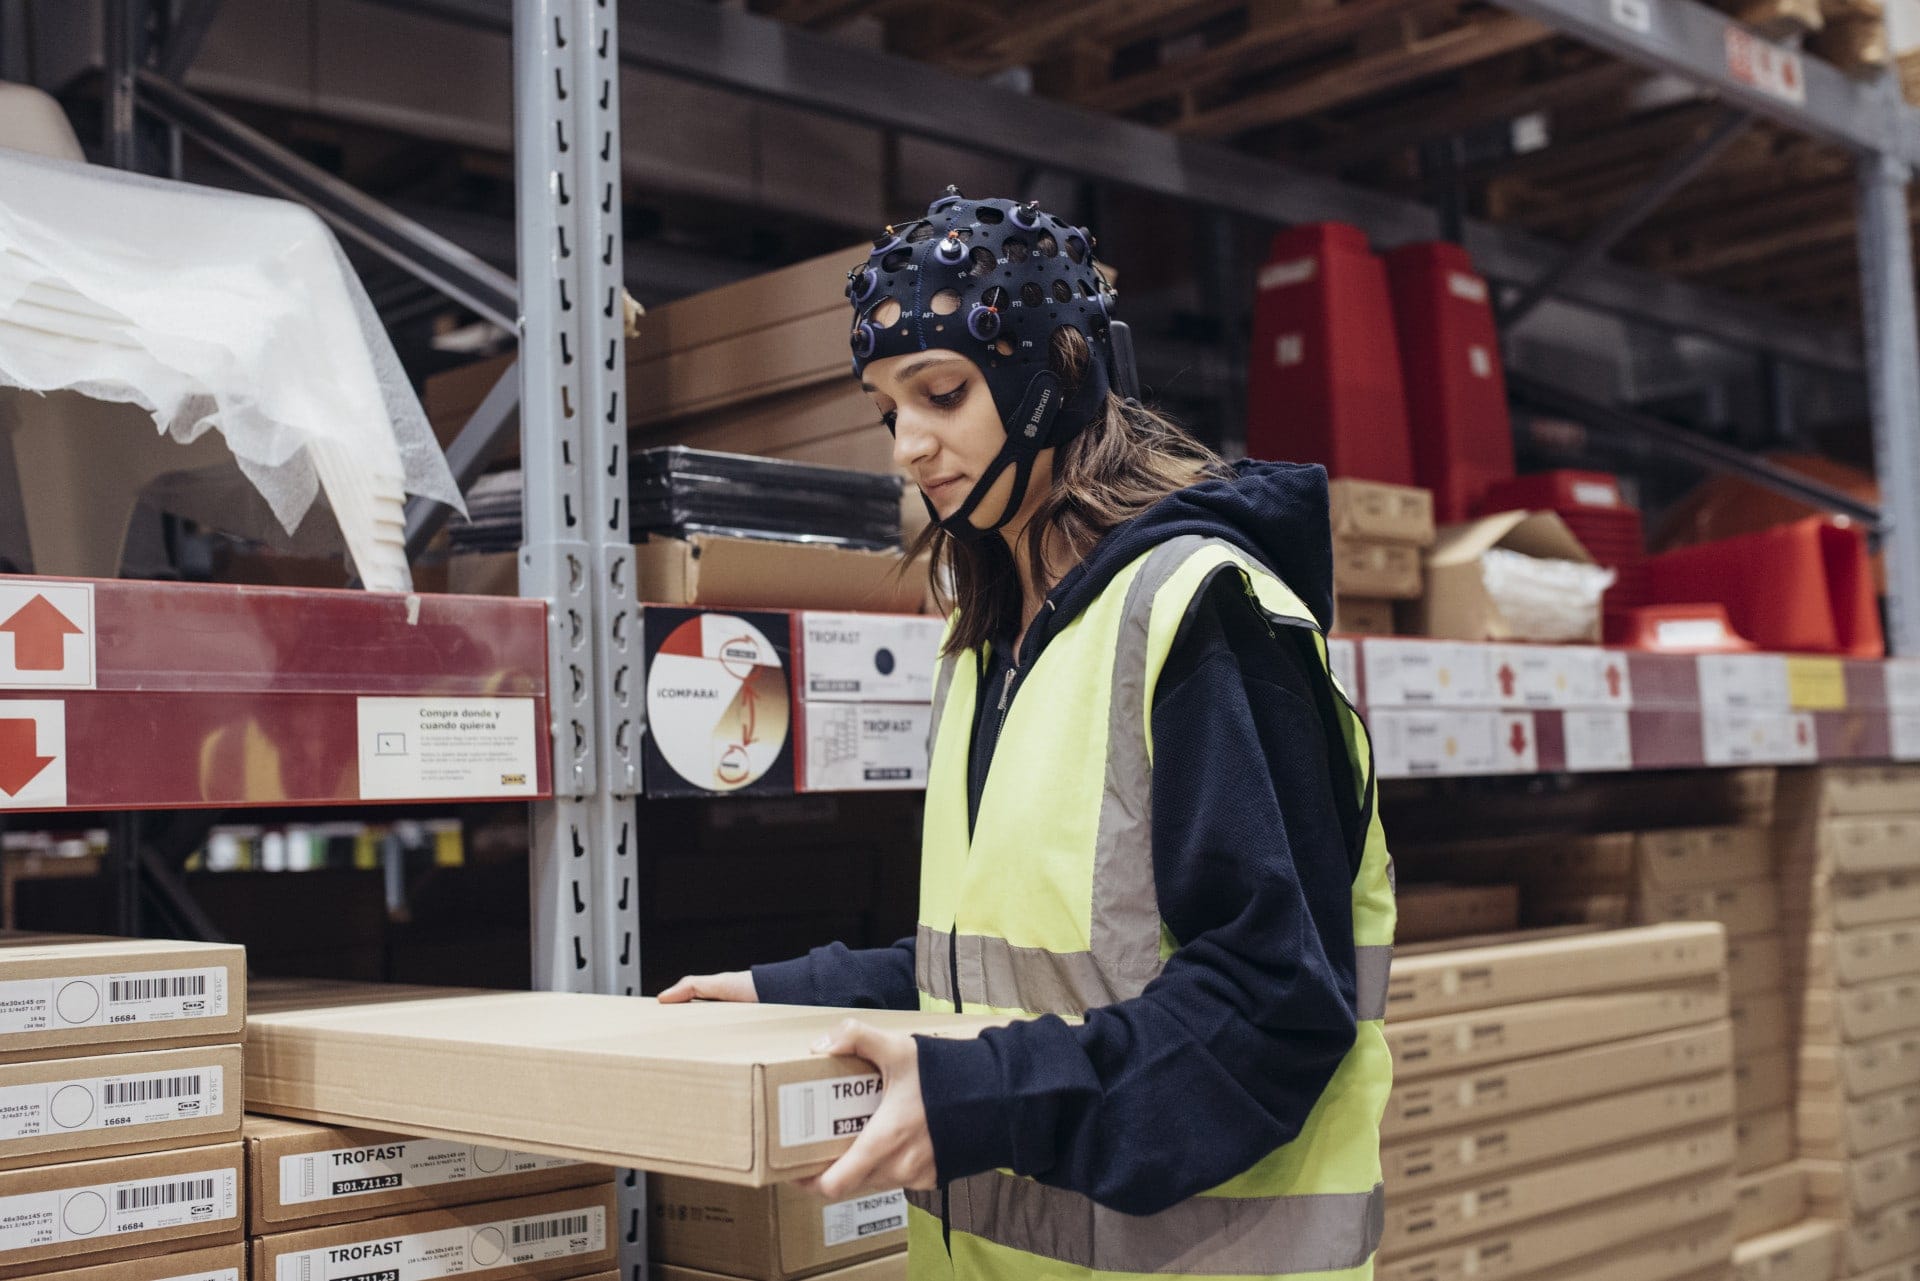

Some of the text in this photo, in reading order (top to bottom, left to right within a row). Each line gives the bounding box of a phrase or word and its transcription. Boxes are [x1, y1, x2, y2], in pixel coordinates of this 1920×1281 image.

[1031, 388, 1051, 424] Bitbrain
[809, 631, 860, 643] TROFAST
[656, 688, 719, 698] ¡COMPARA!
[419, 708, 459, 720] Compra
[462, 709, 492, 718] donde
[420, 720, 496, 732] cuando quieras
[864, 720, 912, 732] TROFAST
[110, 1014, 136, 1022] 16684
[832, 1078, 883, 1100] TROFA
[104, 1116, 131, 1126] 16684
[332, 1146, 406, 1166] TROFAST
[515, 1162, 536, 1171] 16684
[336, 1176, 399, 1193] 301.711.23
[857, 1192, 902, 1212] TROFAST
[117, 1222, 144, 1232] 16684
[328, 1240, 402, 1264] TROFAST
[513, 1254, 534, 1263] 16684
